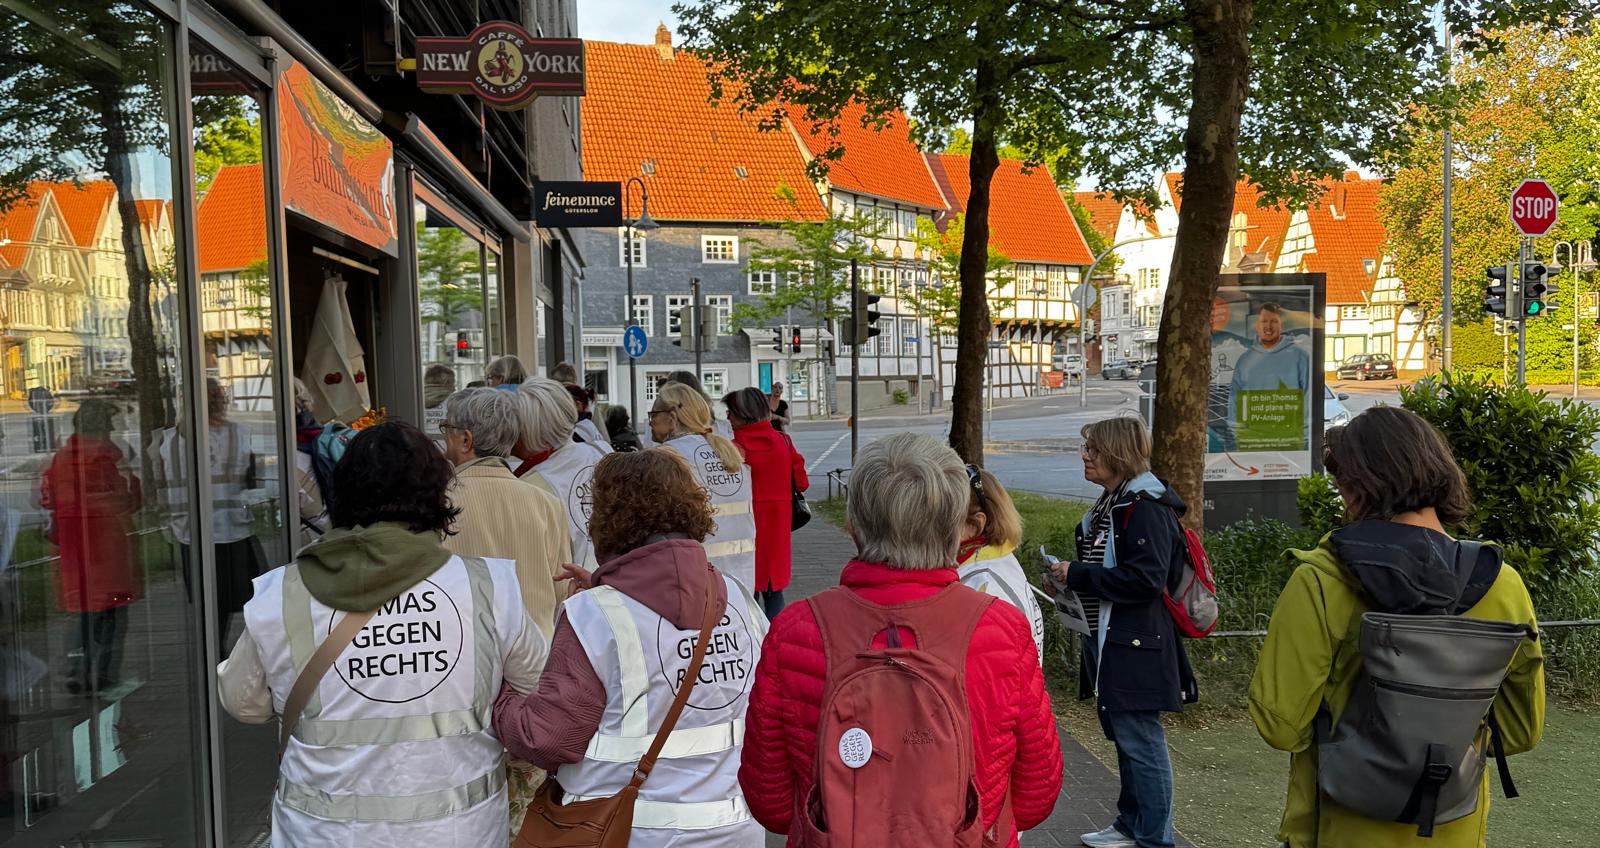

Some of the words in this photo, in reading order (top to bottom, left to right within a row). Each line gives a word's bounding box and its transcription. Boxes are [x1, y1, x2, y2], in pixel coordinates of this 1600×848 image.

[423, 51, 471, 71] NEW
[524, 52, 582, 73] YORK
[475, 76, 497, 94] DAL
[502, 75, 528, 94] 1930
[1515, 196, 1554, 219] STOP
[707, 474, 741, 486] RECHTS
[377, 591, 437, 616] MAS
[352, 620, 442, 648] GEGEN
[348, 650, 449, 679] RECHTS
[676, 659, 745, 689] RCHTS
[842, 738, 851, 761] OMAS
[849, 735, 858, 761] GEGEN
[855, 732, 864, 761] RECHTS
